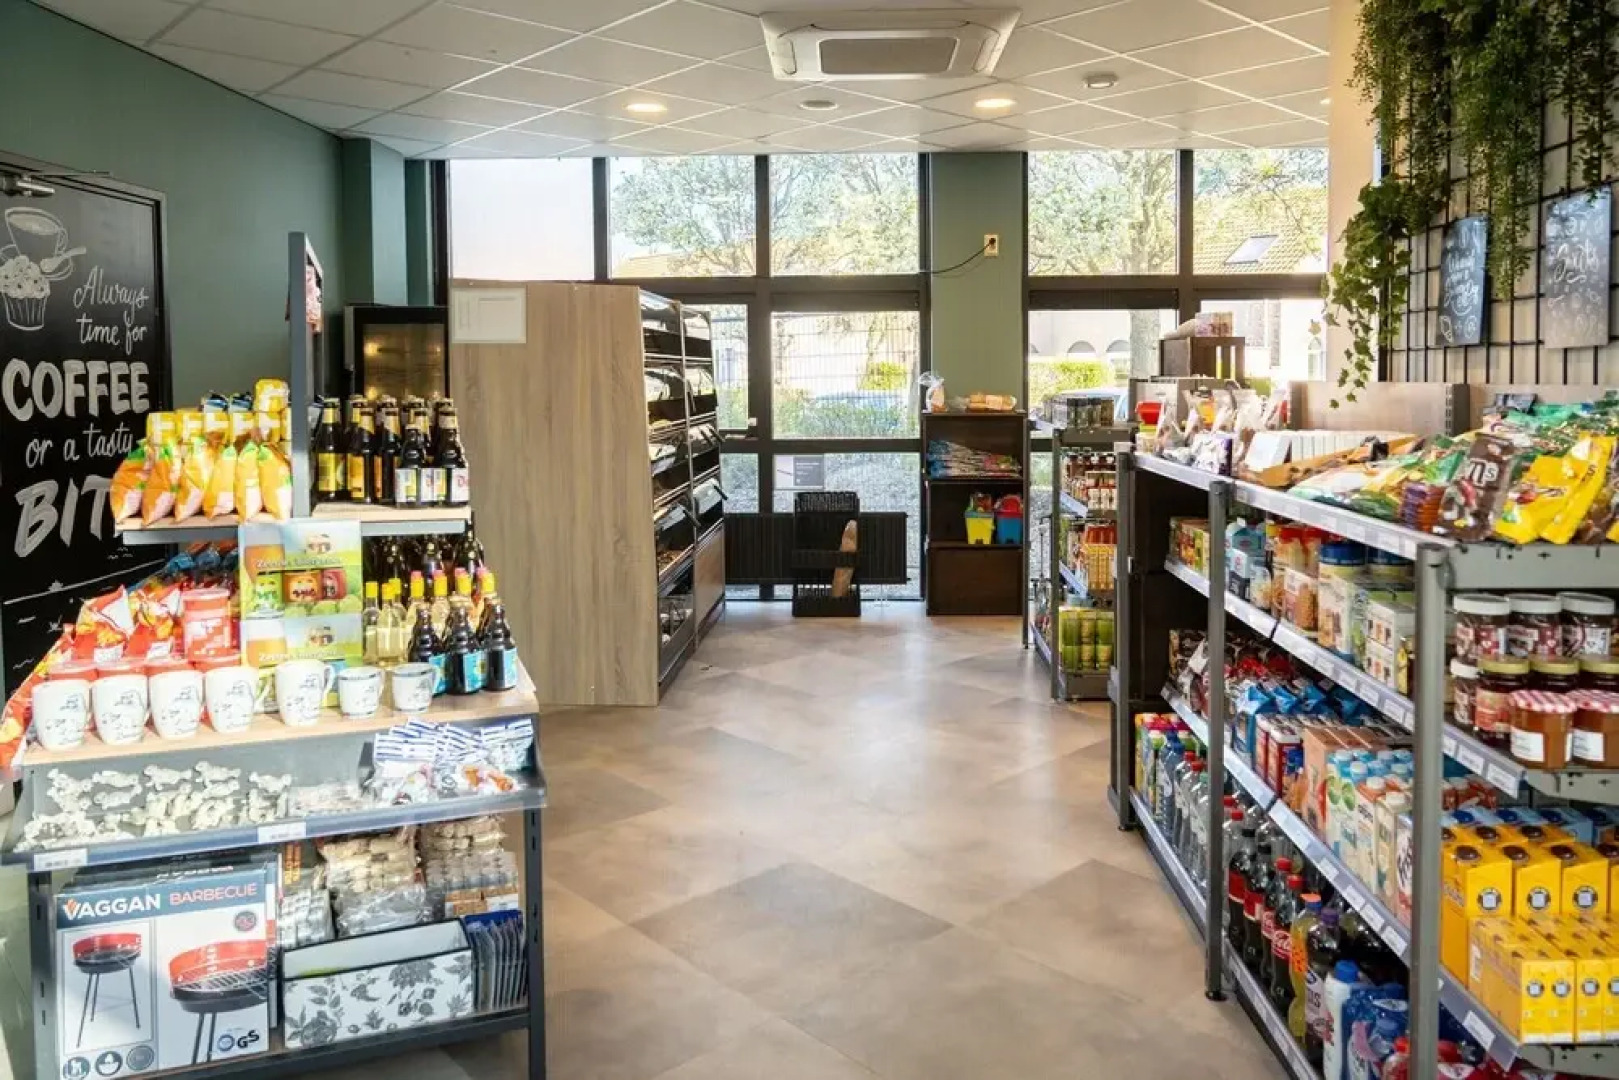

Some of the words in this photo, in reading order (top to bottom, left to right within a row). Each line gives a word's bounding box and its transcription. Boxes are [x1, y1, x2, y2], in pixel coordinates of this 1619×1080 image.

[74, 265, 149, 326] Always
[76, 313, 120, 345] time
[124, 322, 147, 355] for
[2, 358, 150, 422] COFFEE
[25, 438, 54, 469] or
[63, 438, 80, 461] a
[83, 422, 134, 459] tasty
[13, 475, 120, 559] BIT
[63, 893, 161, 920] VAGGAN
[169, 883, 257, 905] BARBECUE
[236, 1029, 260, 1050] GS
